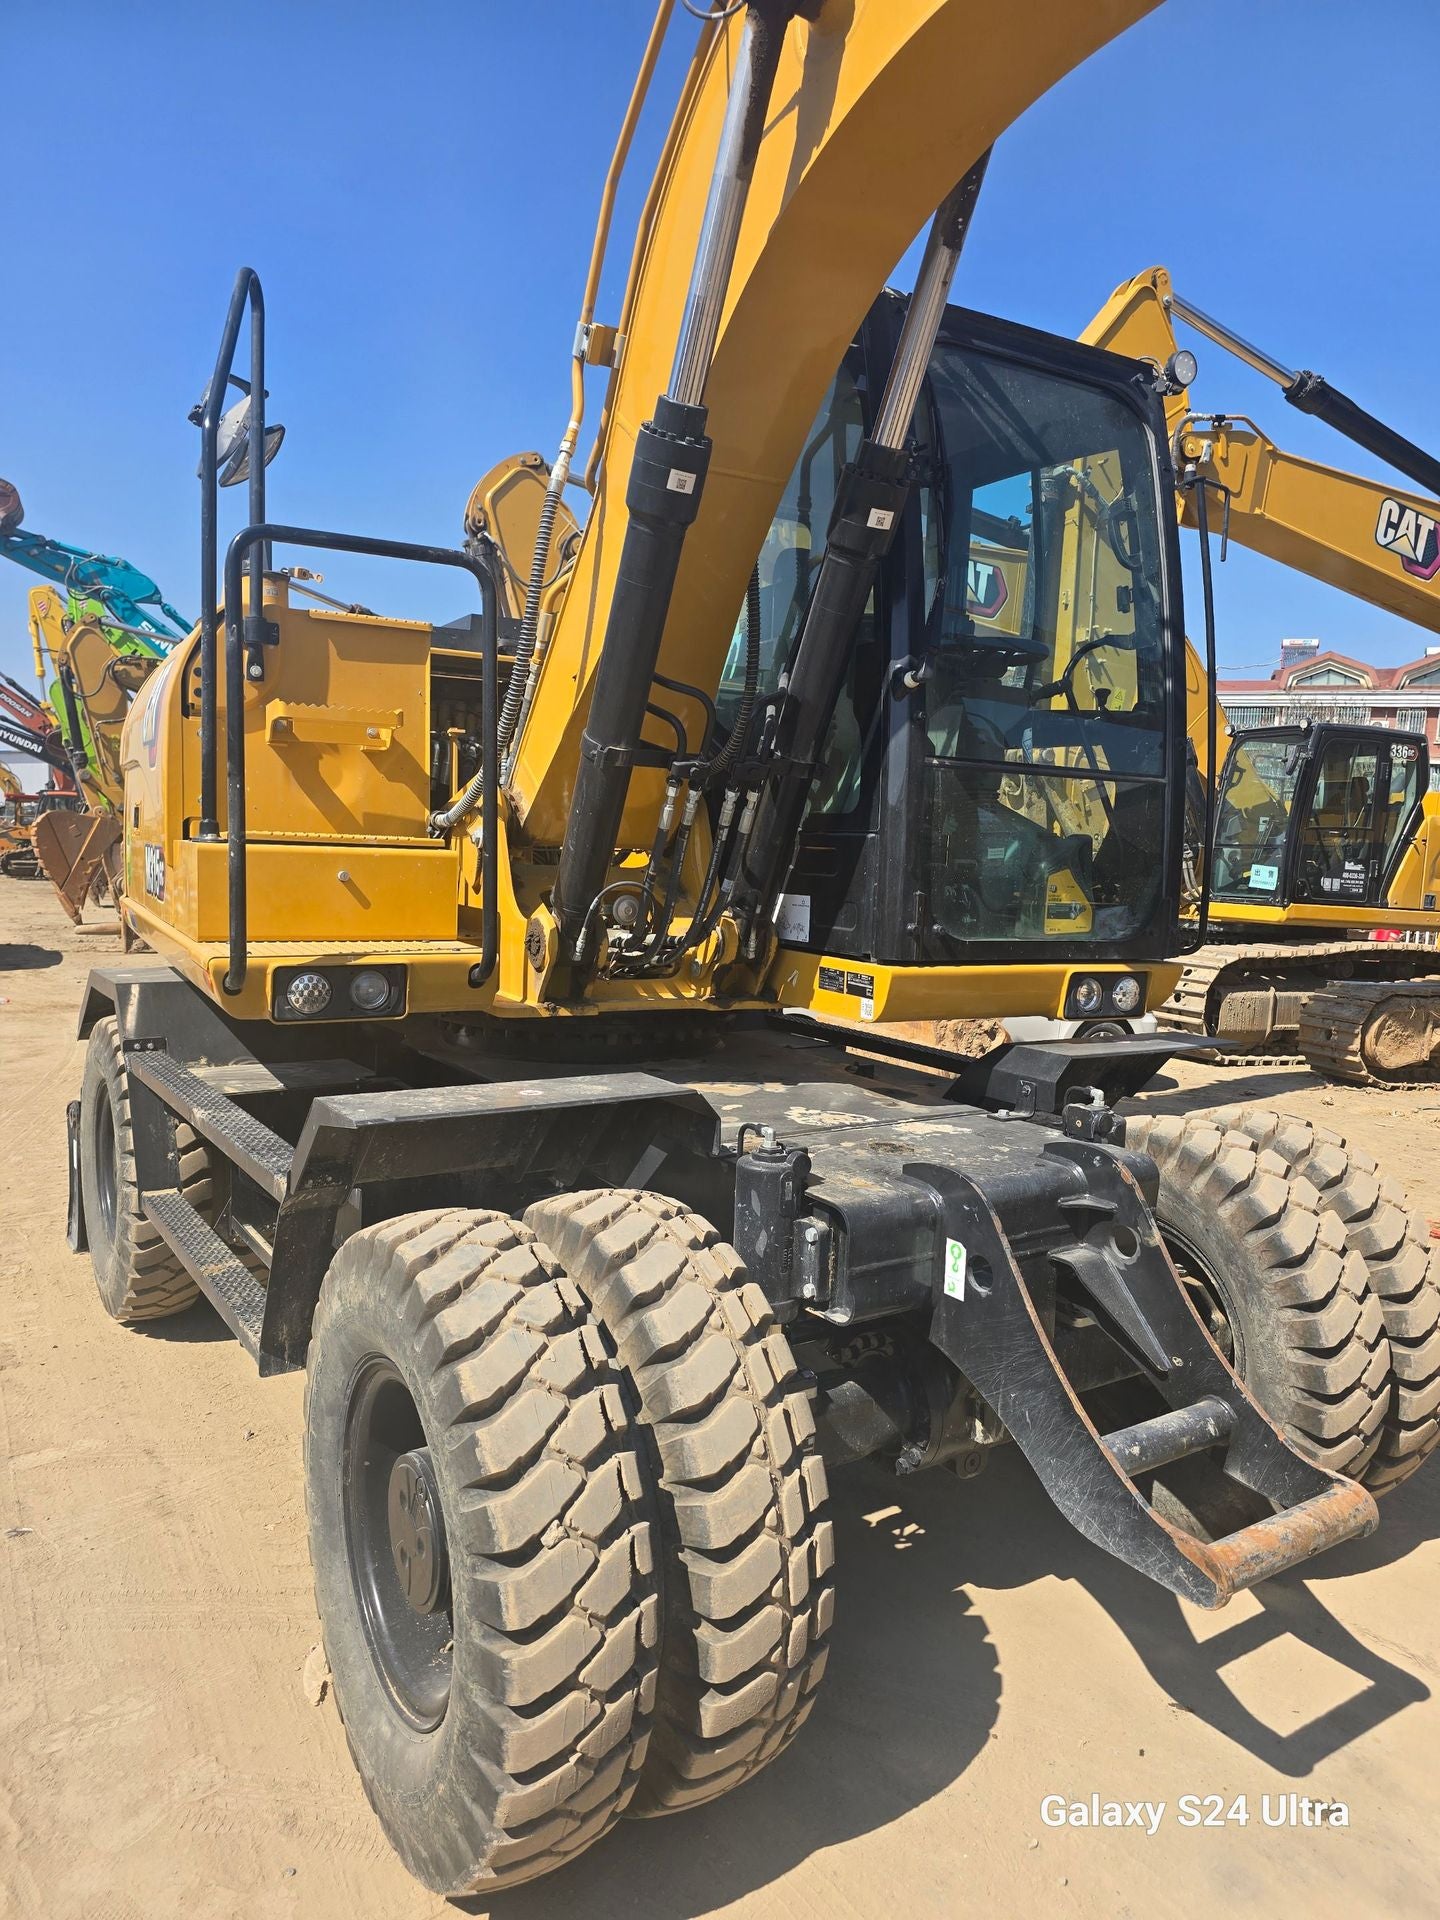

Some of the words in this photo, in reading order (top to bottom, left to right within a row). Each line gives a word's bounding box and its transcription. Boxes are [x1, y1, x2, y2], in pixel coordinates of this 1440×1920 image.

[1376, 499, 1435, 562] CAT
[967, 560, 994, 604] AT
[0, 693, 33, 717] DOOSAN
[1390, 744, 1408, 759] 336
